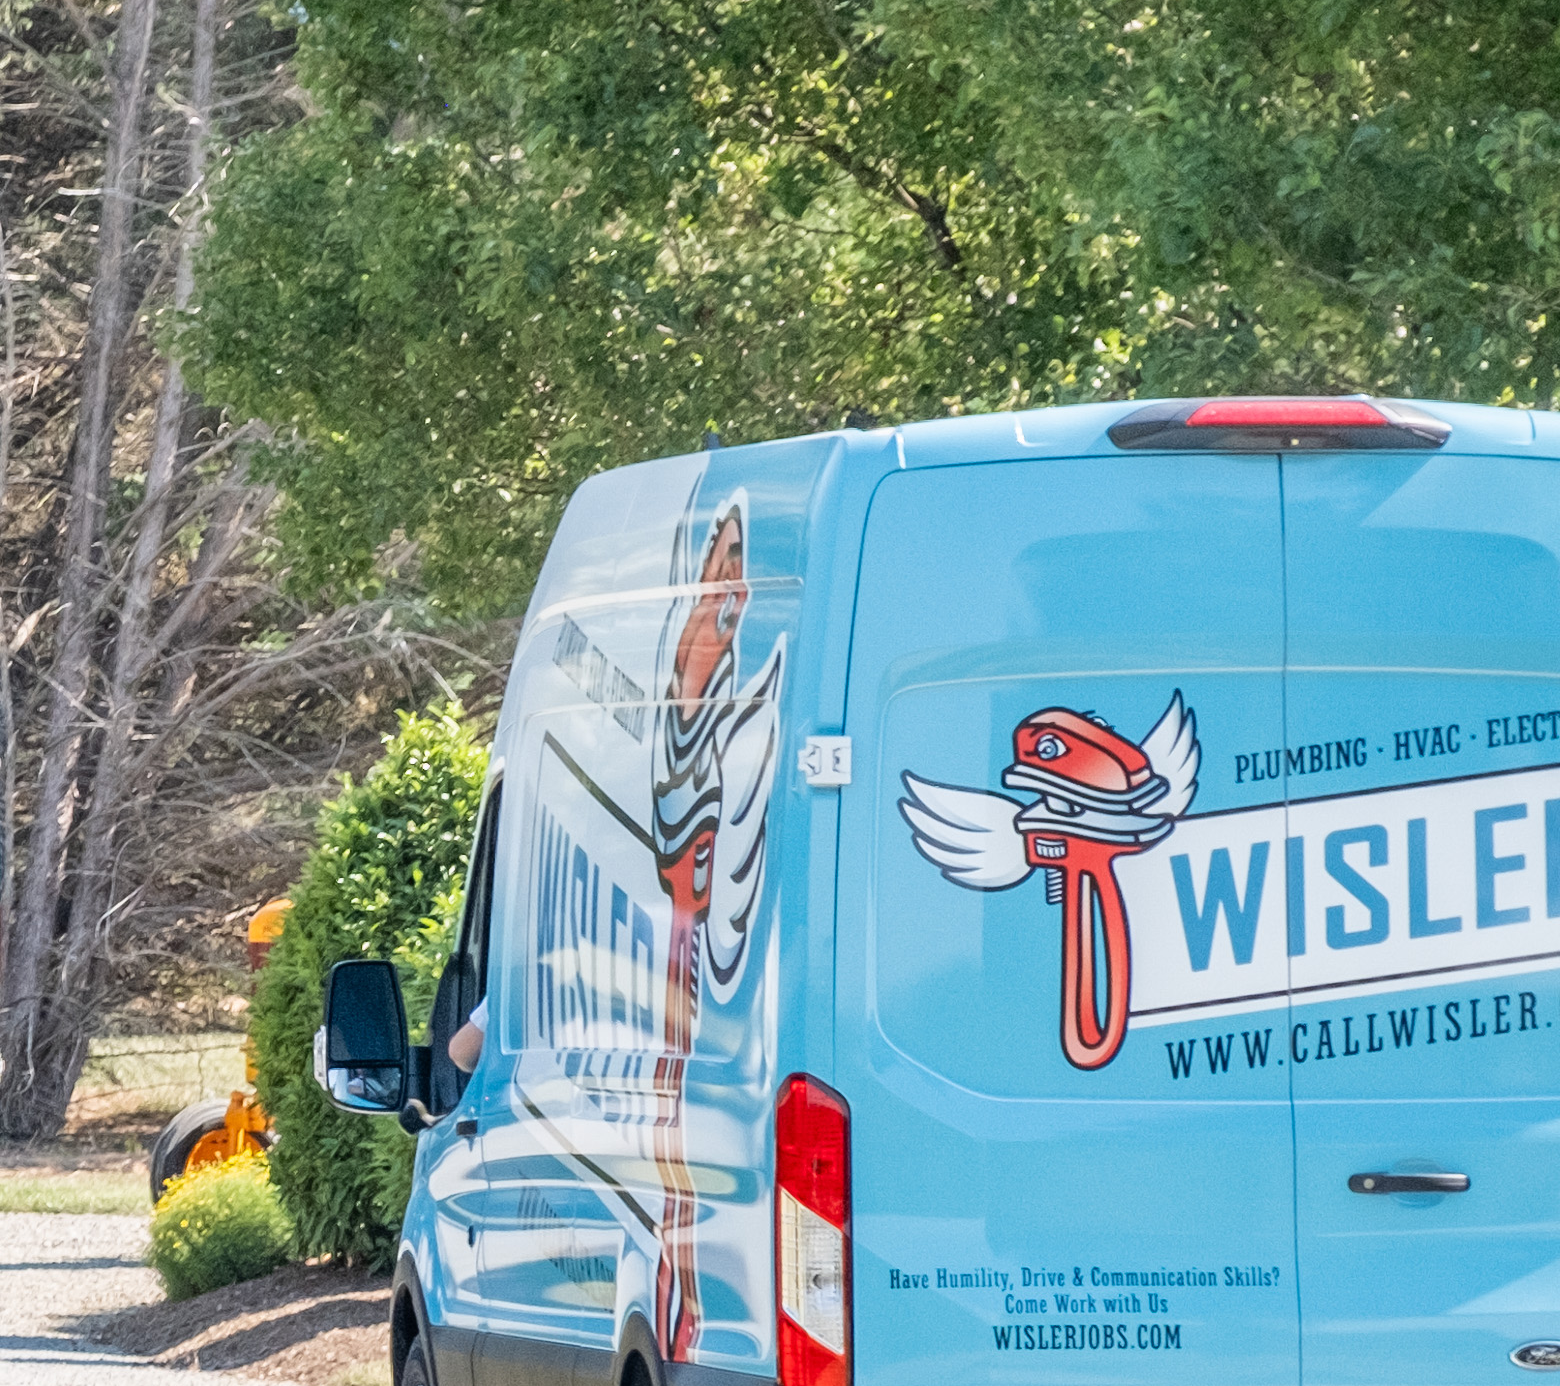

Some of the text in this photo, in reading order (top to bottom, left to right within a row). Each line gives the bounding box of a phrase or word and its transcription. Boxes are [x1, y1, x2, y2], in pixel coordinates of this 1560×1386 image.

[1235, 737, 1368, 784] PLUMBING
[1394, 724, 1461, 761] HVAC
[889, 1266, 1280, 1292] Have Humility, Drive & Communication Skills?
[1005, 1292, 1169, 1314] Come Work with Us
[993, 1324, 1182, 1350] WISLERJOBS.COM
